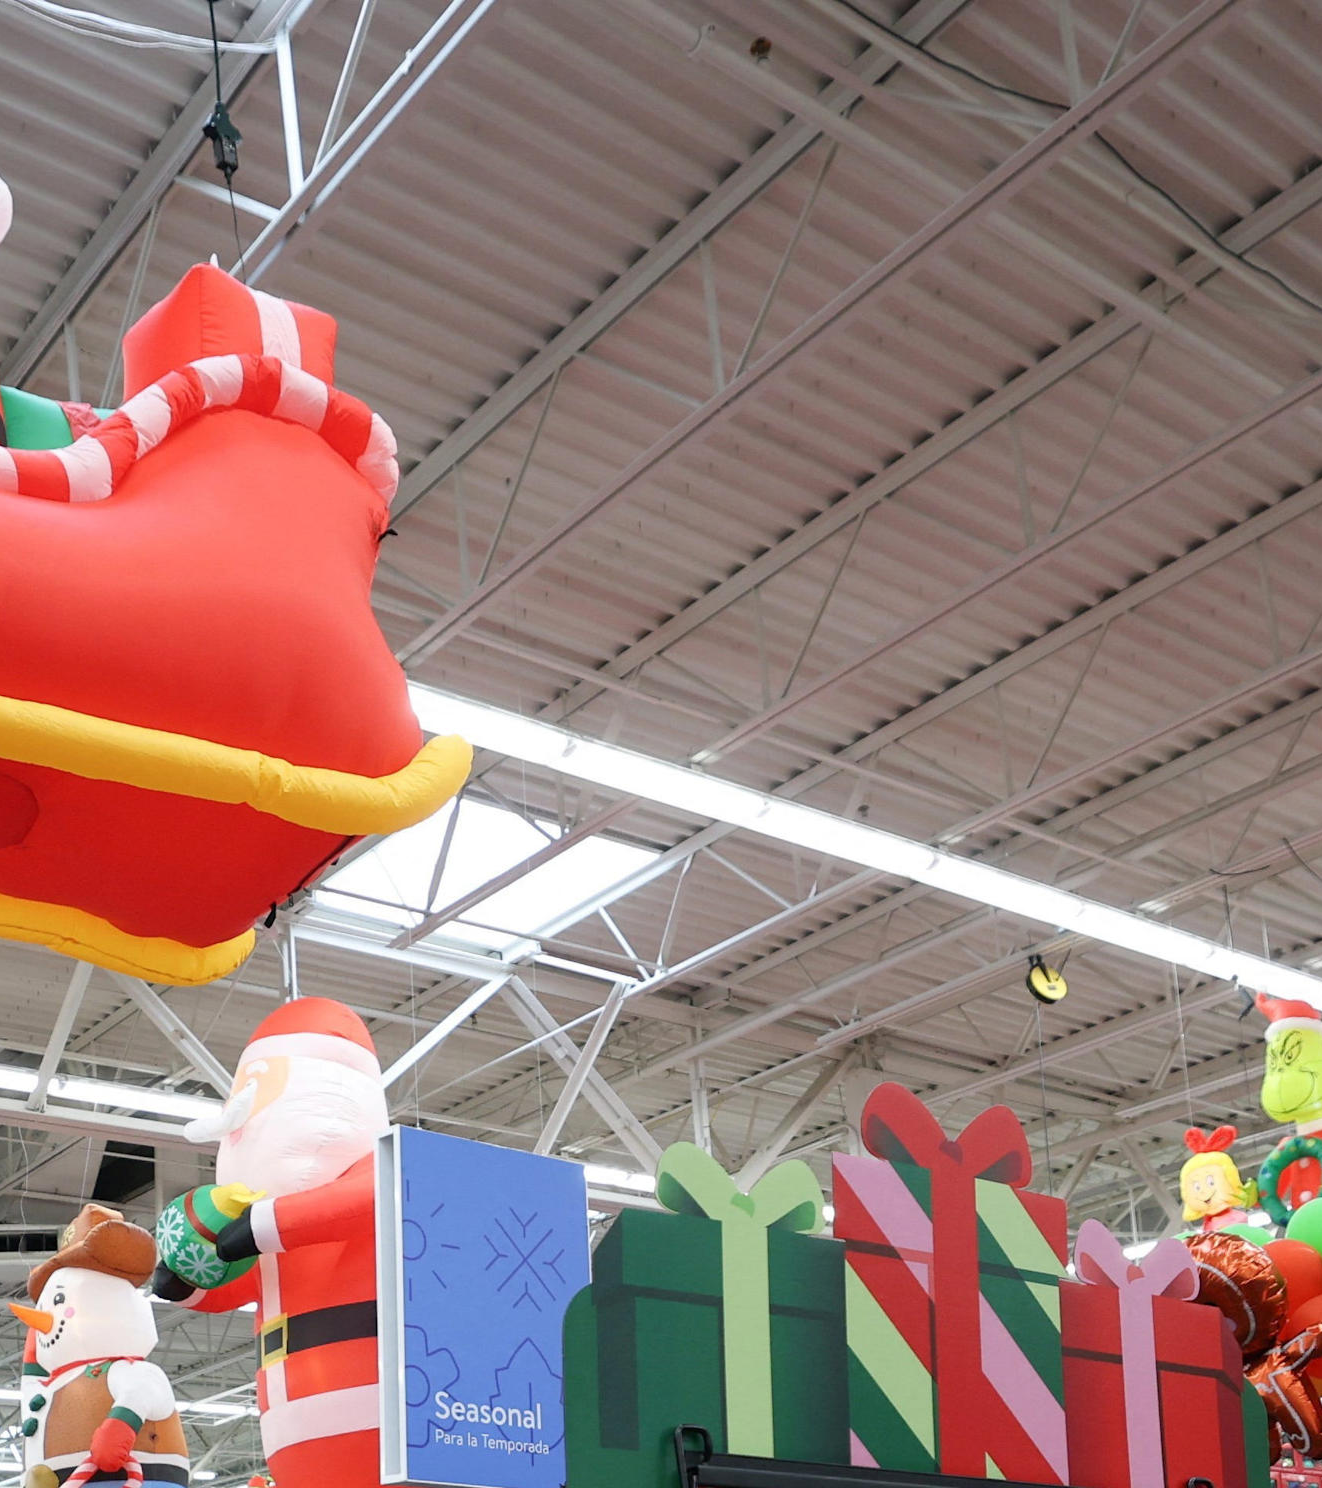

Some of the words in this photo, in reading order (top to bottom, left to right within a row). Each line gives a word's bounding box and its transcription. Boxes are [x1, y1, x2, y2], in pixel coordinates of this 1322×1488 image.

[435, 1391, 542, 1430] Seasonal
[435, 1429, 464, 1446] Para
[467, 1432, 477, 1447] la
[480, 1434, 549, 1456] Temporada
